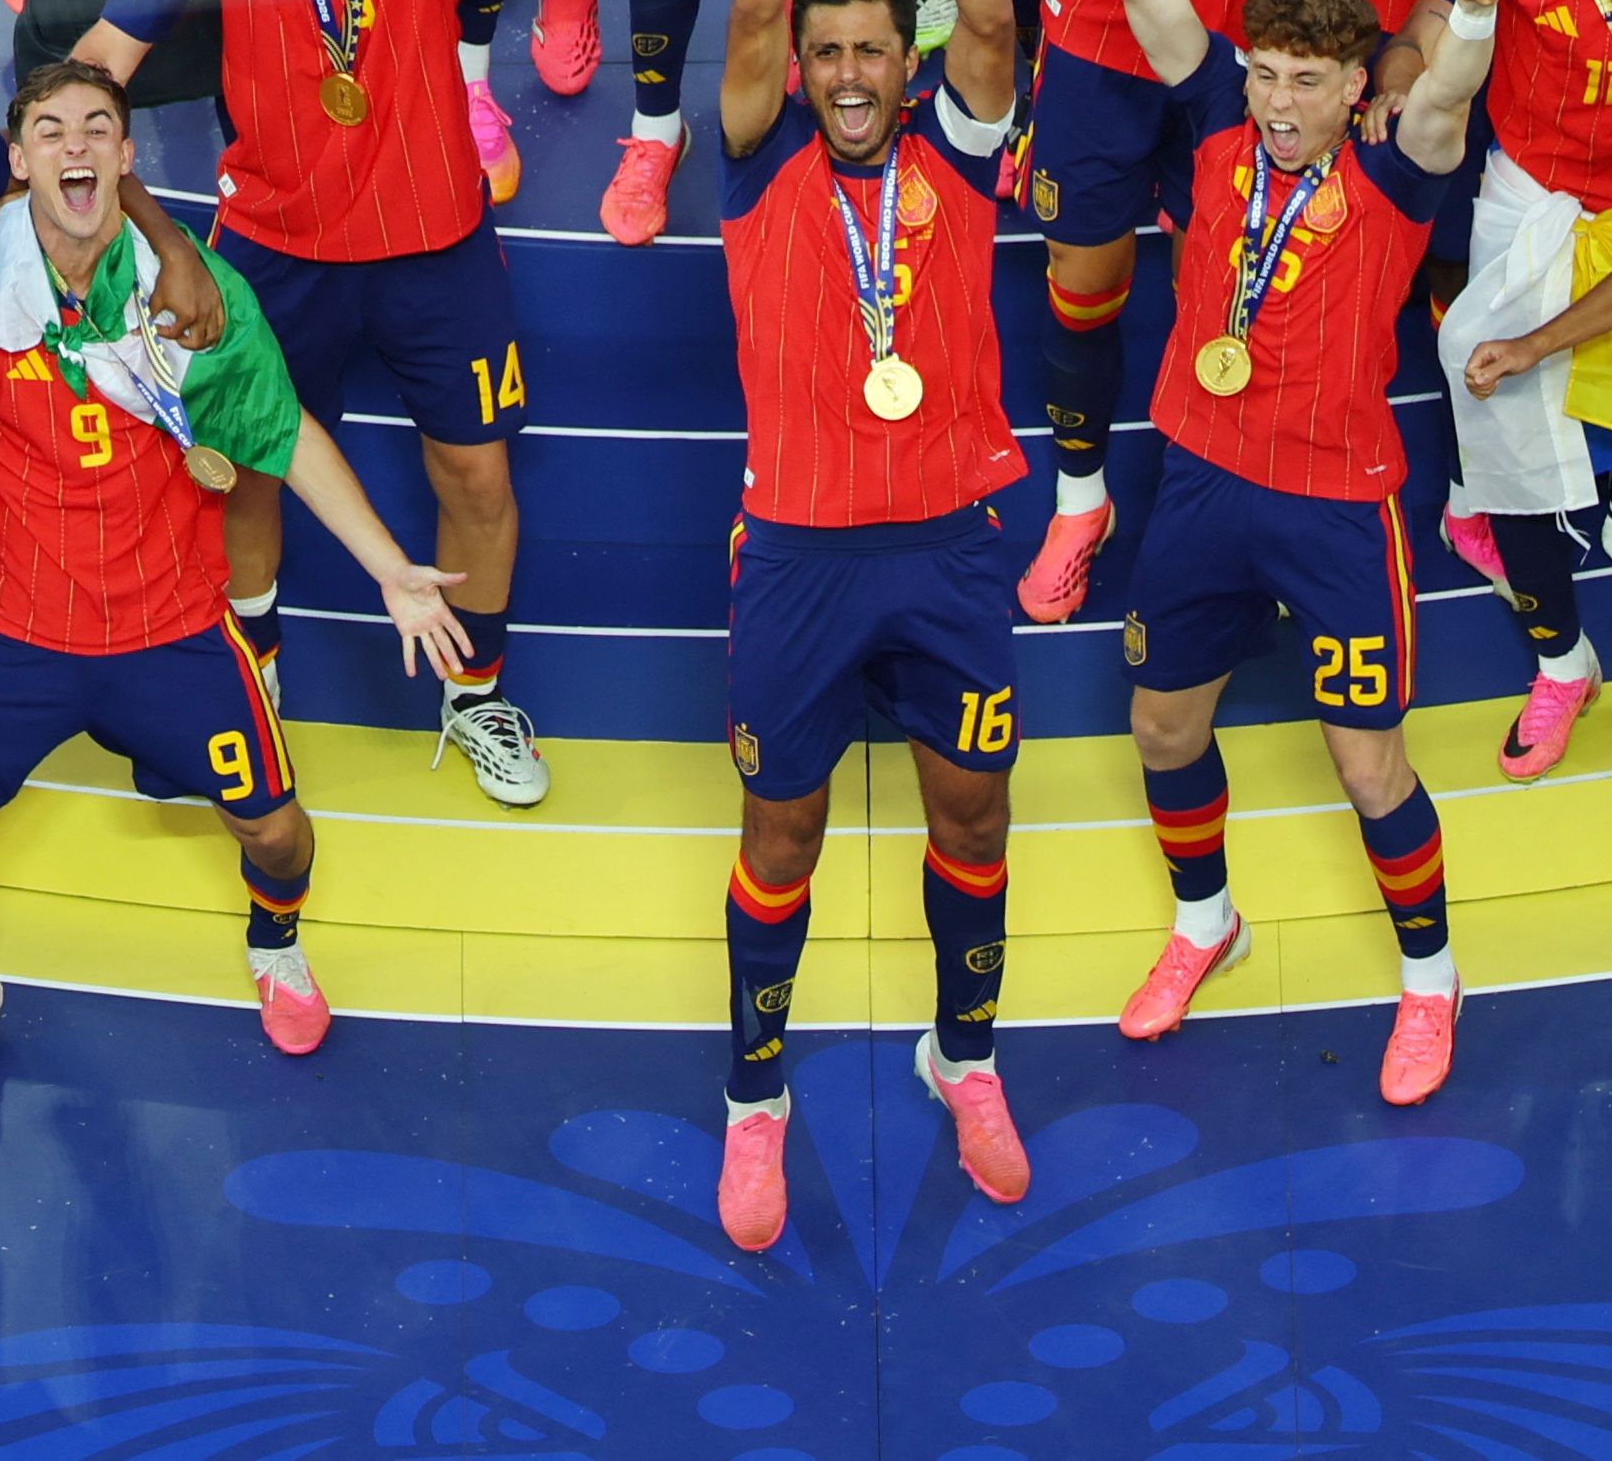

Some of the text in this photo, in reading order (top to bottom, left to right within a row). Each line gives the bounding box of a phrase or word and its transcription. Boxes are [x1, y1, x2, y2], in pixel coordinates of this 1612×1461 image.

[881, 169, 896, 271] WORLD CUP 2026
[1250, 170, 1265, 229] CUP 2026
[841, 203, 870, 289] FIFA WORLD CUP
[1252, 191, 1305, 299] FIFA WORLD CUP 2026
[137, 383, 192, 448] FIFA WORLD CU
[471, 341, 526, 425] 14
[71, 403, 113, 469] 9
[1312, 635, 1388, 707] 25
[957, 685, 1013, 753] 16
[208, 730, 254, 801] 9
